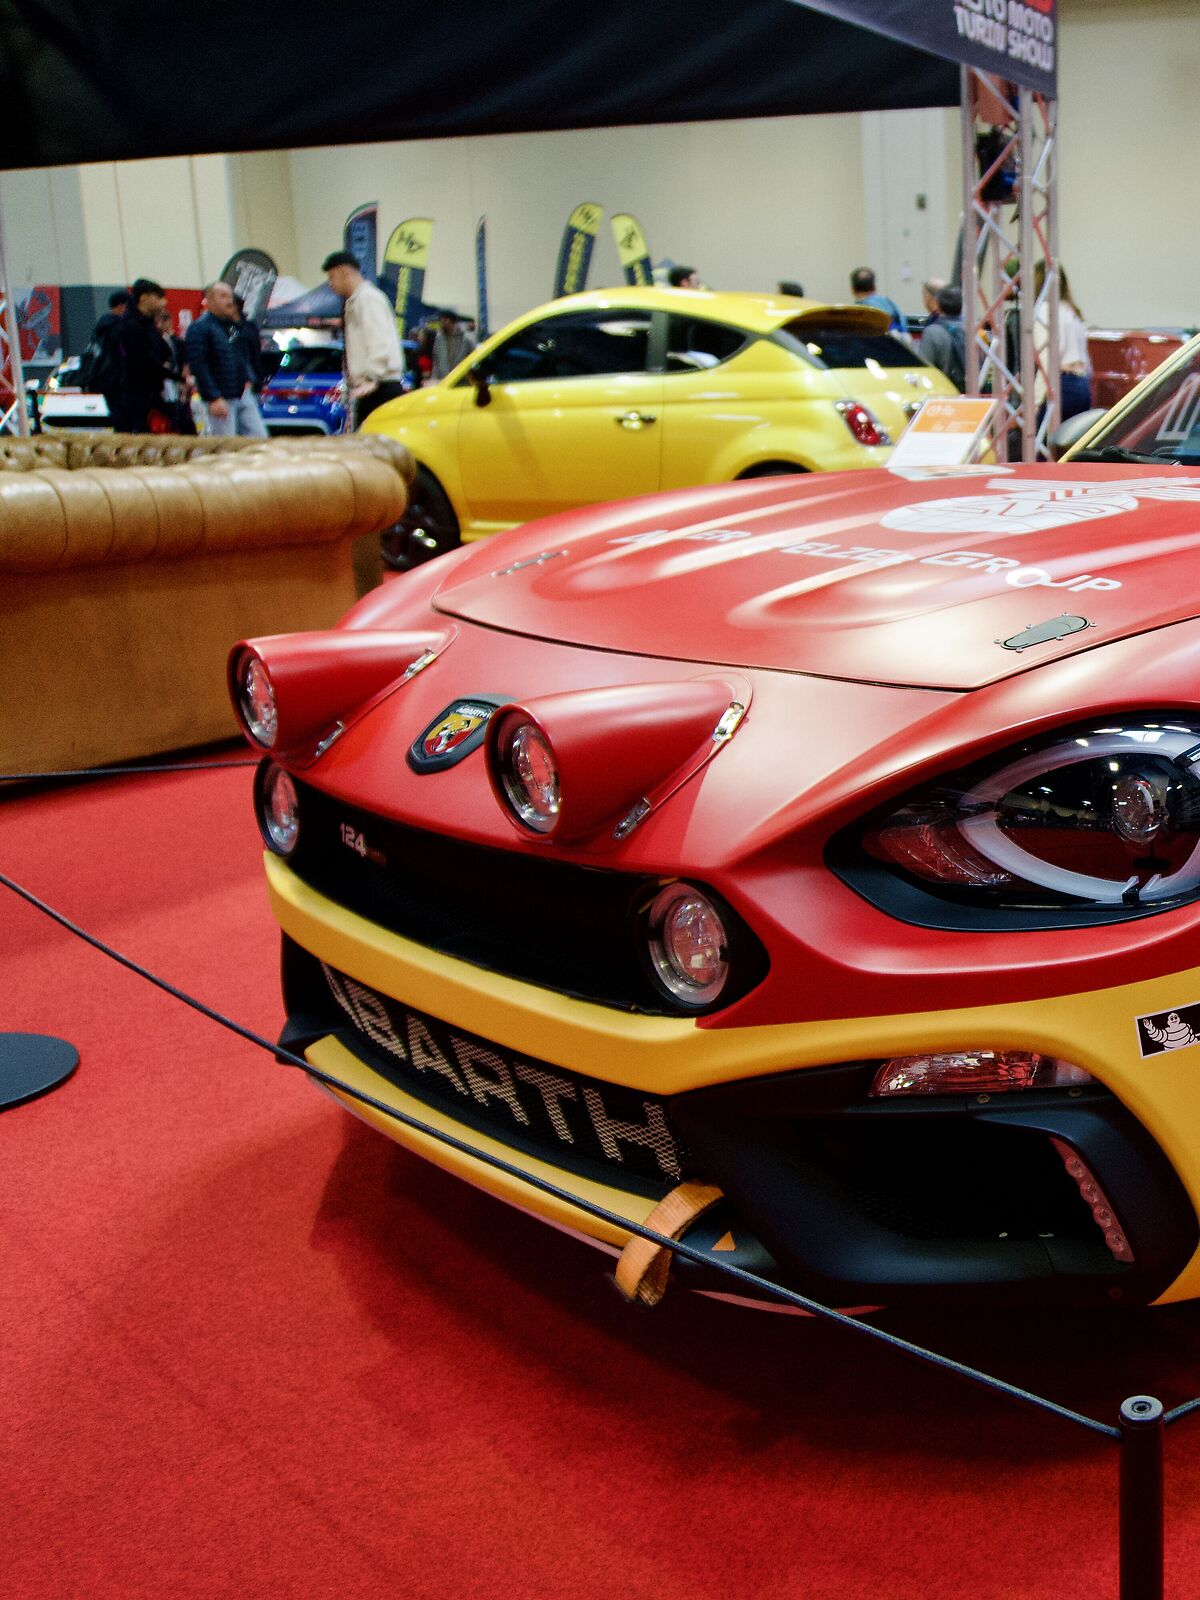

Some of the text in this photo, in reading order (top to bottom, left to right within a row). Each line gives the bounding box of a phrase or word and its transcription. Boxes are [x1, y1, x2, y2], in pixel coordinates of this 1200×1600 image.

[954, 5, 1054, 73] TURIN SHOW
[1008, 0, 1054, 43] MOTO
[340, 822, 367, 857] 124
